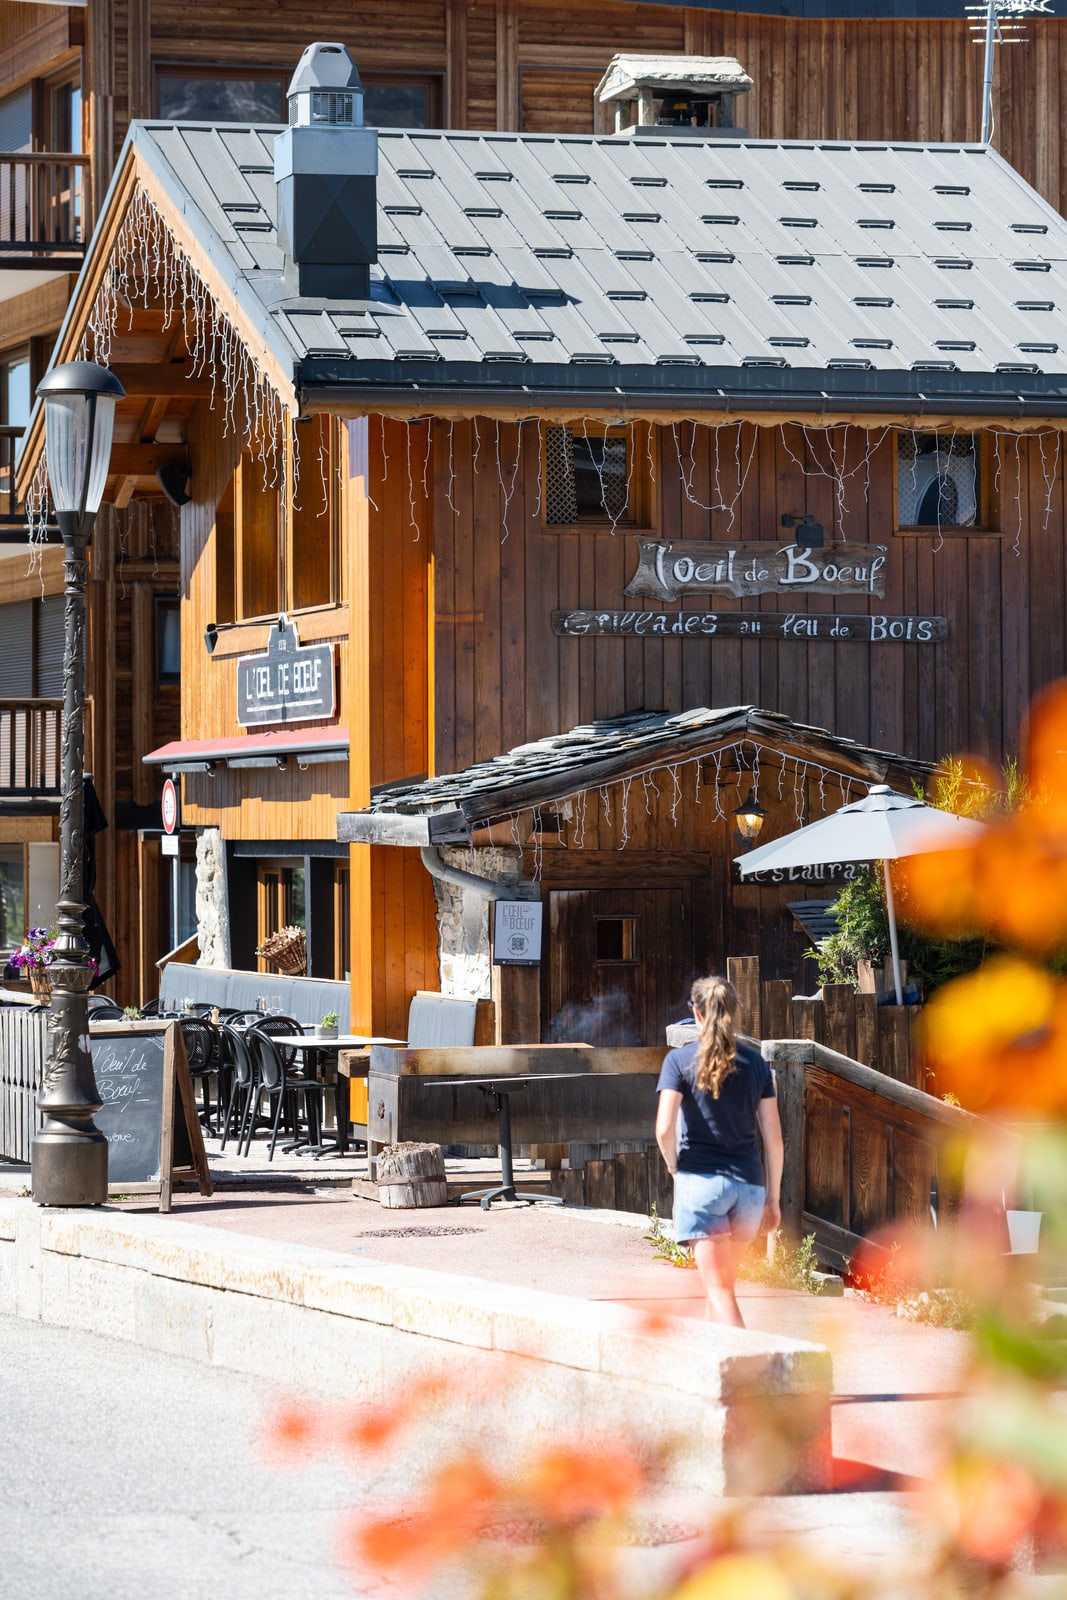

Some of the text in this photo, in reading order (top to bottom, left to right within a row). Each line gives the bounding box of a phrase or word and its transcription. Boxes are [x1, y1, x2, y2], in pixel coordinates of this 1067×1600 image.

[744, 558, 769, 581] de
[564, 612, 933, 641] Grillades au feu de Bois
[278, 663, 290, 696] DE
